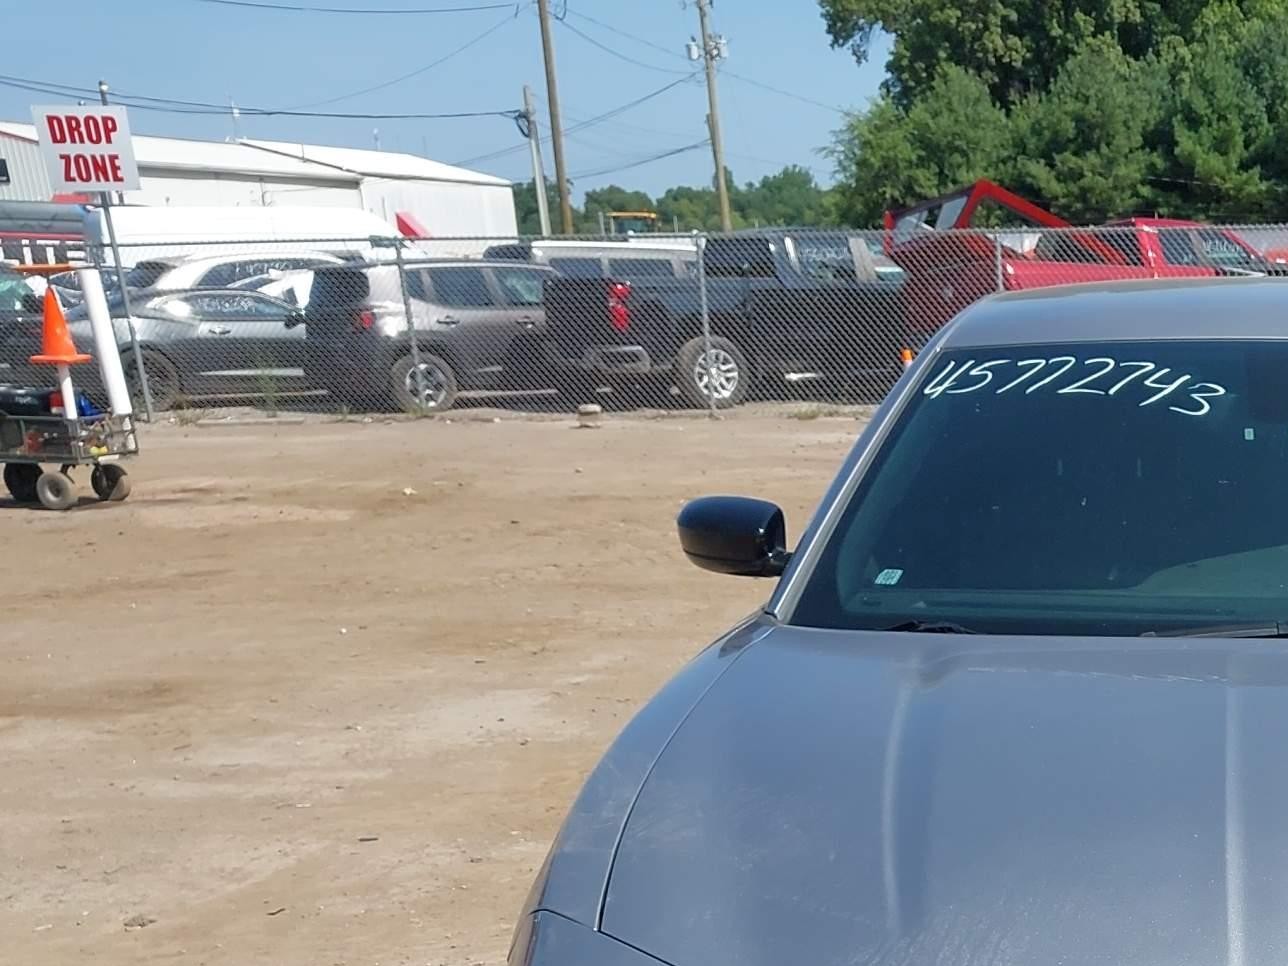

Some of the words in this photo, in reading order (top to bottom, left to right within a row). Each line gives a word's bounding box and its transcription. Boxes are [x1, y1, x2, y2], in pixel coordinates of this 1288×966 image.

[46, 115, 118, 144] DROP
[59, 154, 125, 183] ZONE
[924, 356, 1226, 416] 45772743
